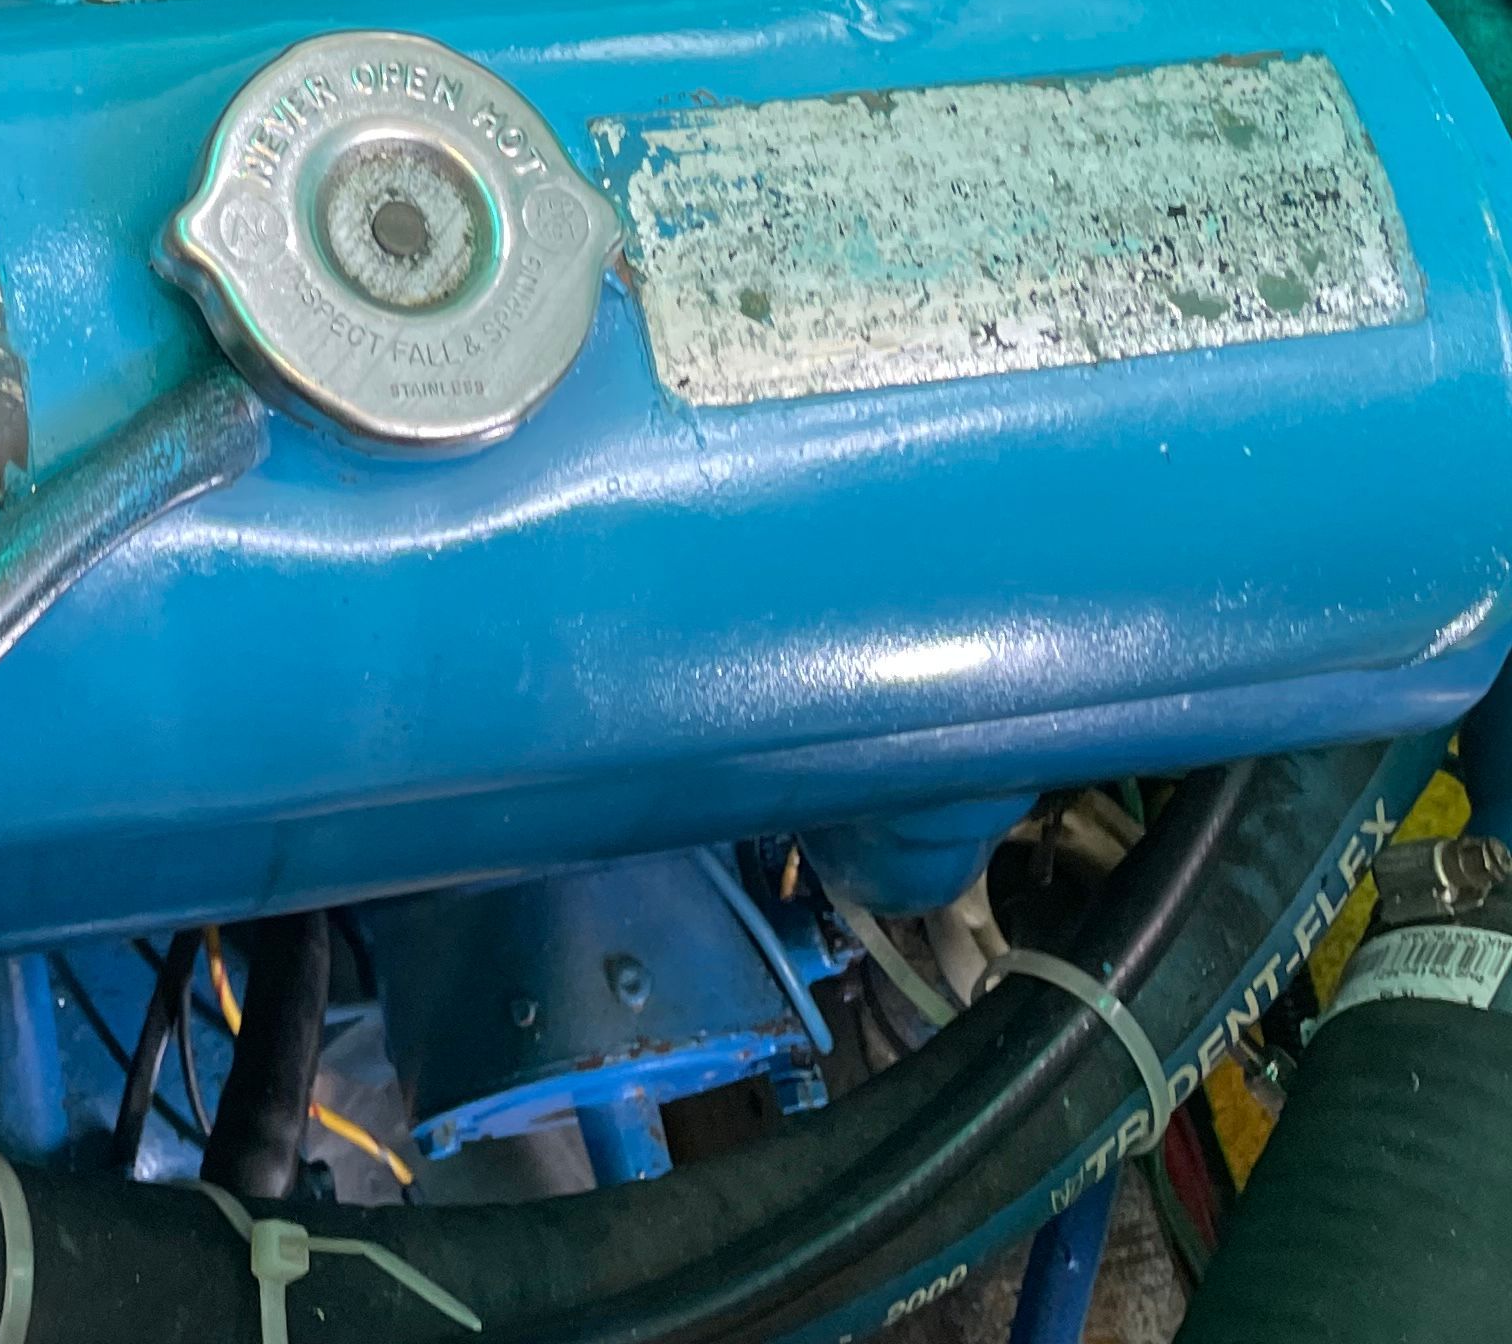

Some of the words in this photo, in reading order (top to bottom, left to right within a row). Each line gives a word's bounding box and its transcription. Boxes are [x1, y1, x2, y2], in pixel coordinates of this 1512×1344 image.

[241, 73, 339, 189] NEVER
[351, 62, 464, 111] OPEN
[469, 102, 549, 178] HOT
[391, 339, 463, 368] FALL
[465, 333, 482, 359] &
[1084, 797, 1396, 1184] TRDENT-FLEX
